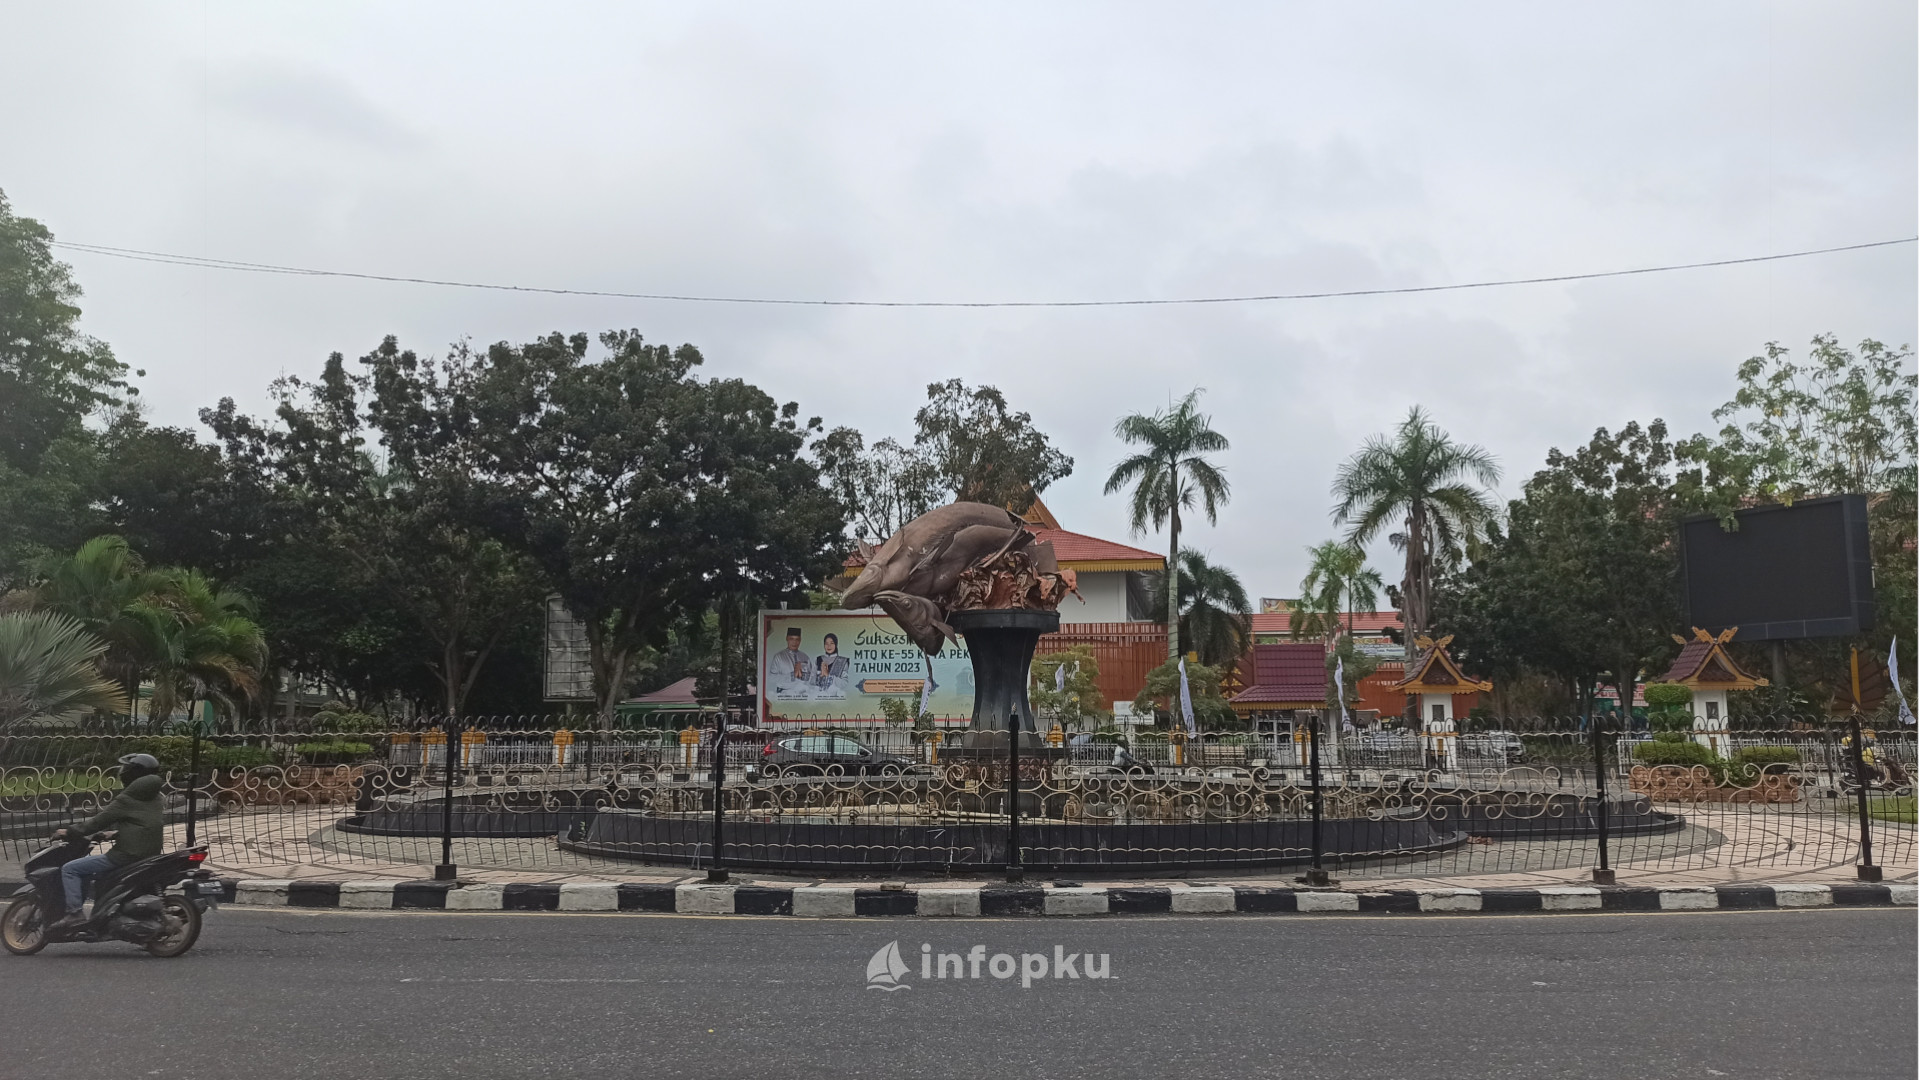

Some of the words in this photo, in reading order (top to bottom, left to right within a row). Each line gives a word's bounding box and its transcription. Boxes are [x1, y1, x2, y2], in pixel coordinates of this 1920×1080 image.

[854, 650, 878, 660] MTQ
[881, 650, 915, 660] KE-55
[854, 663, 892, 673] TAHUN
[894, 663, 920, 673] 2023
